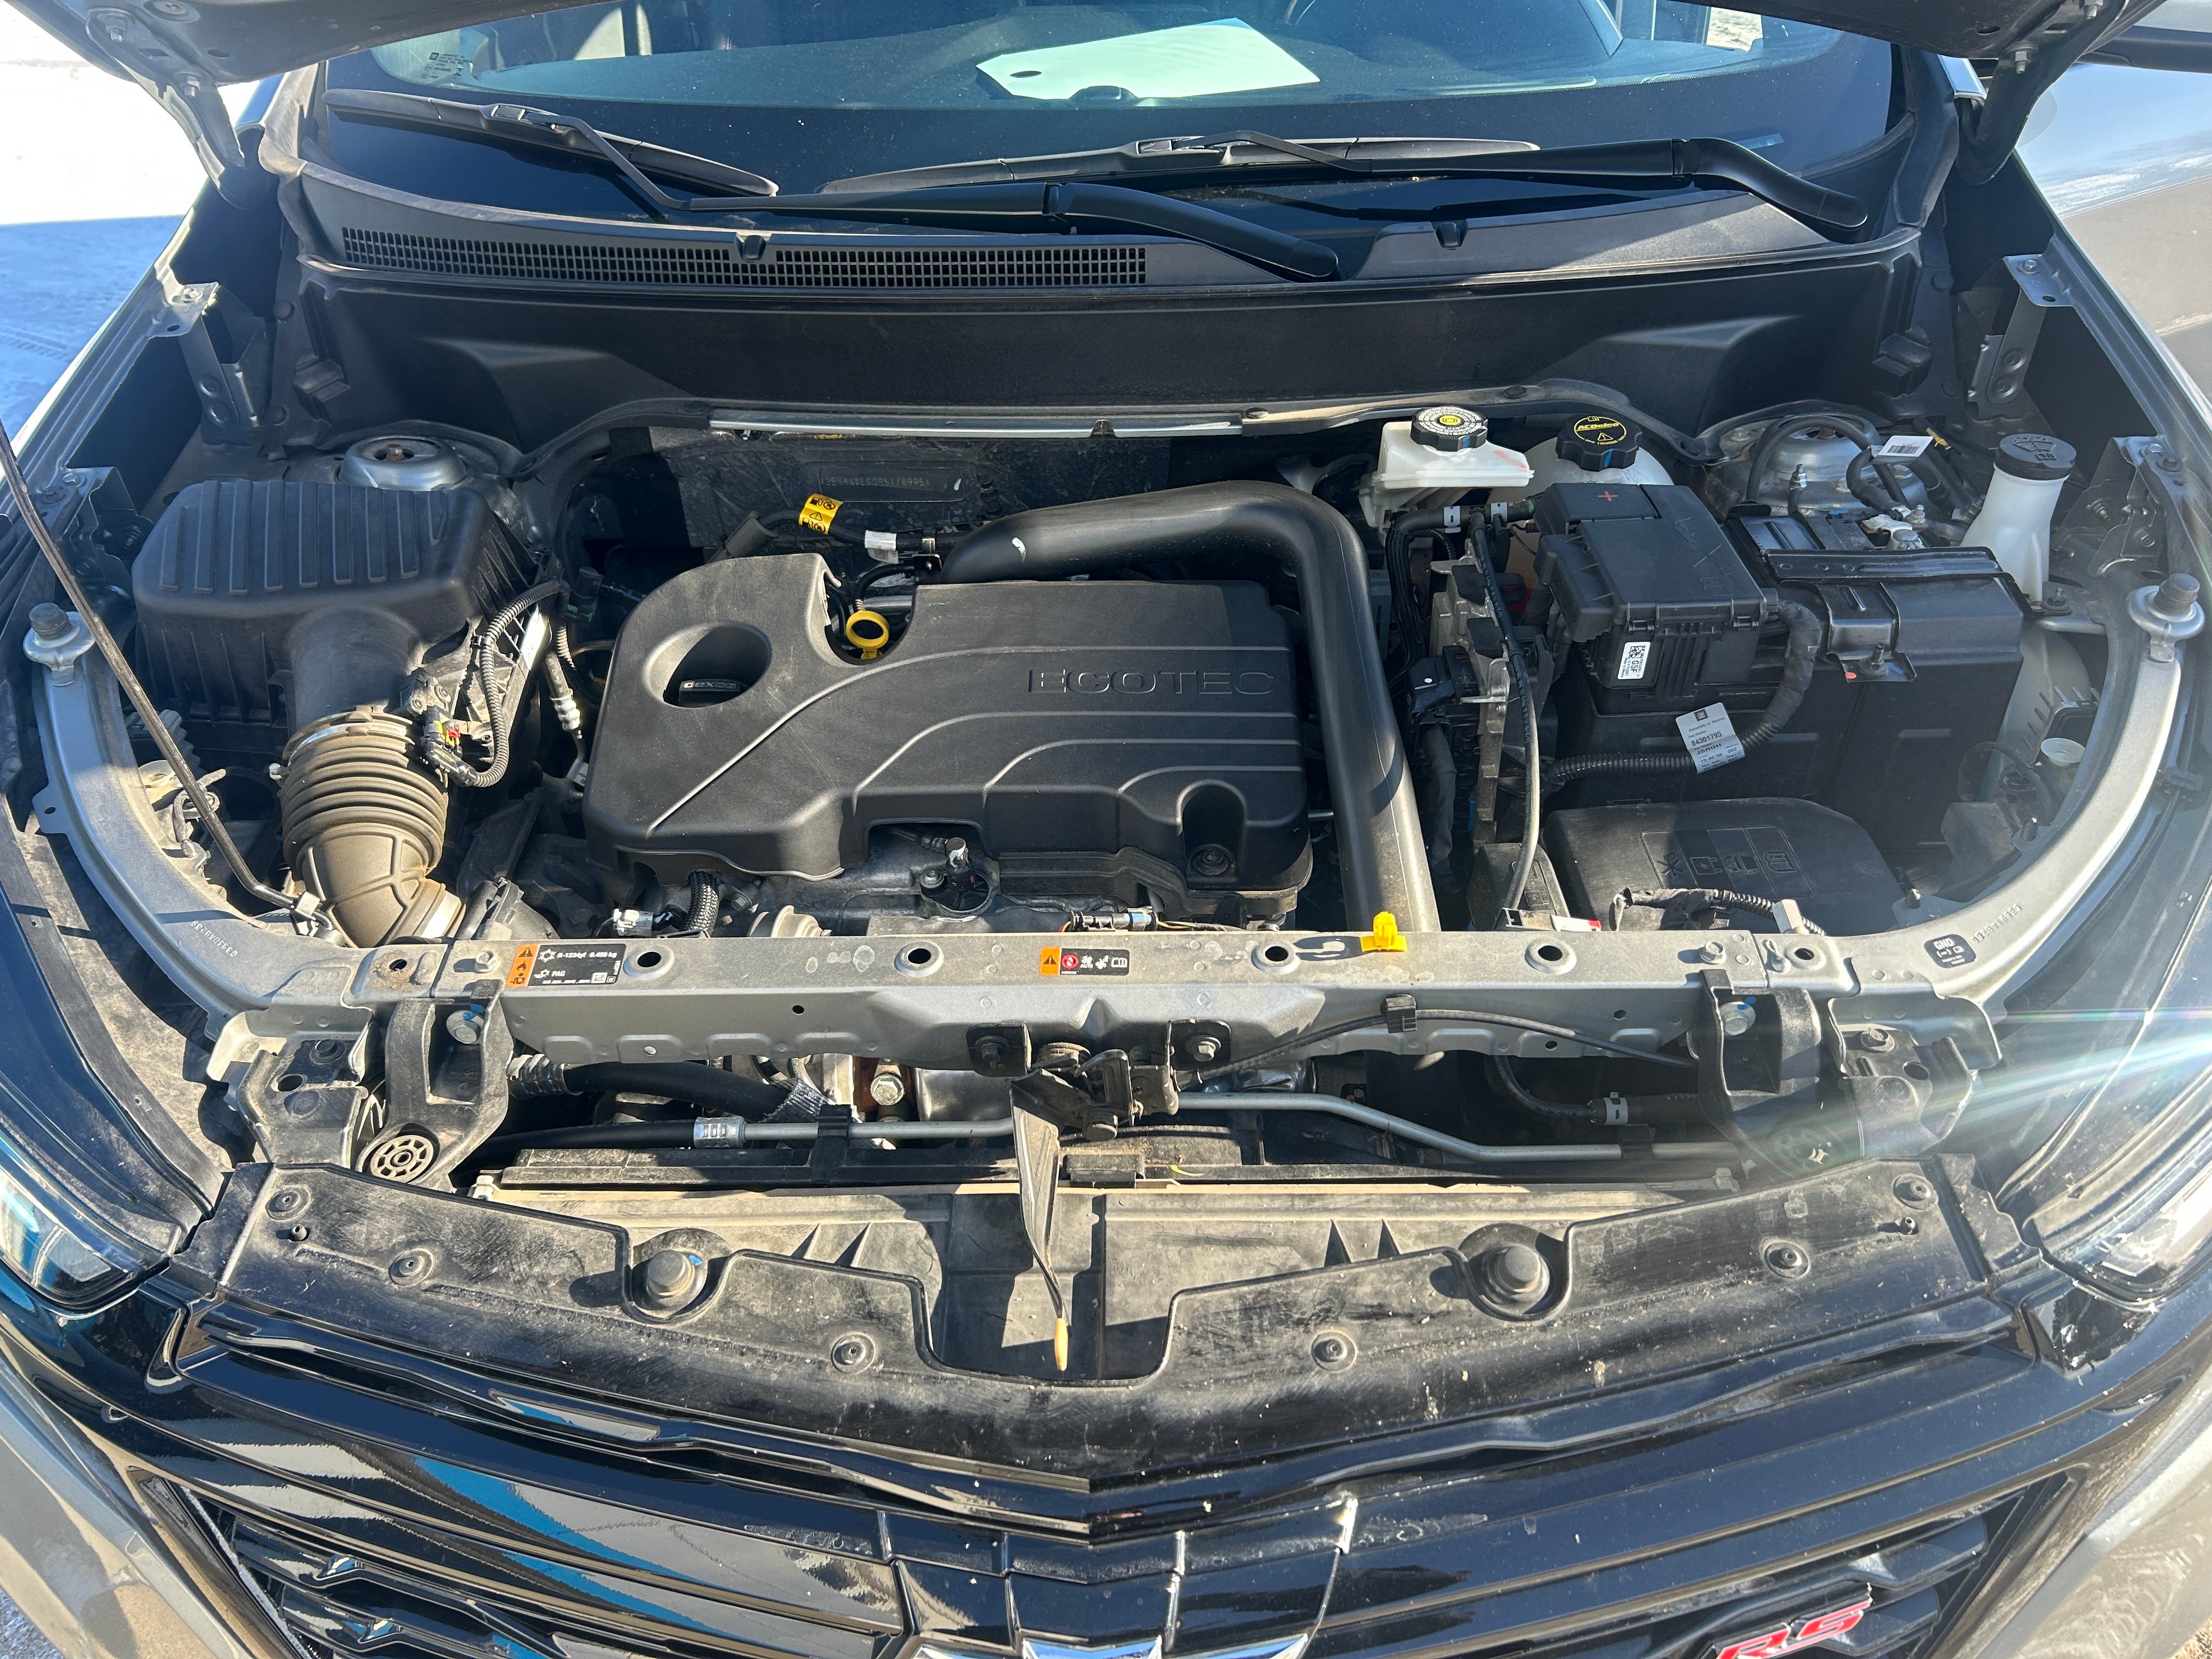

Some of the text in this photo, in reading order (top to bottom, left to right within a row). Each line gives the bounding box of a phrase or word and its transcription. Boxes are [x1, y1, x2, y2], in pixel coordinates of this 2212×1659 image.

[1630, 661, 1639, 673] G5F
[684, 681, 736, 689] dexos
[1028, 669, 1274, 695] ECOTEC
[1691, 731, 1722, 746] 84301795
[1933, 938, 1954, 950] GND
